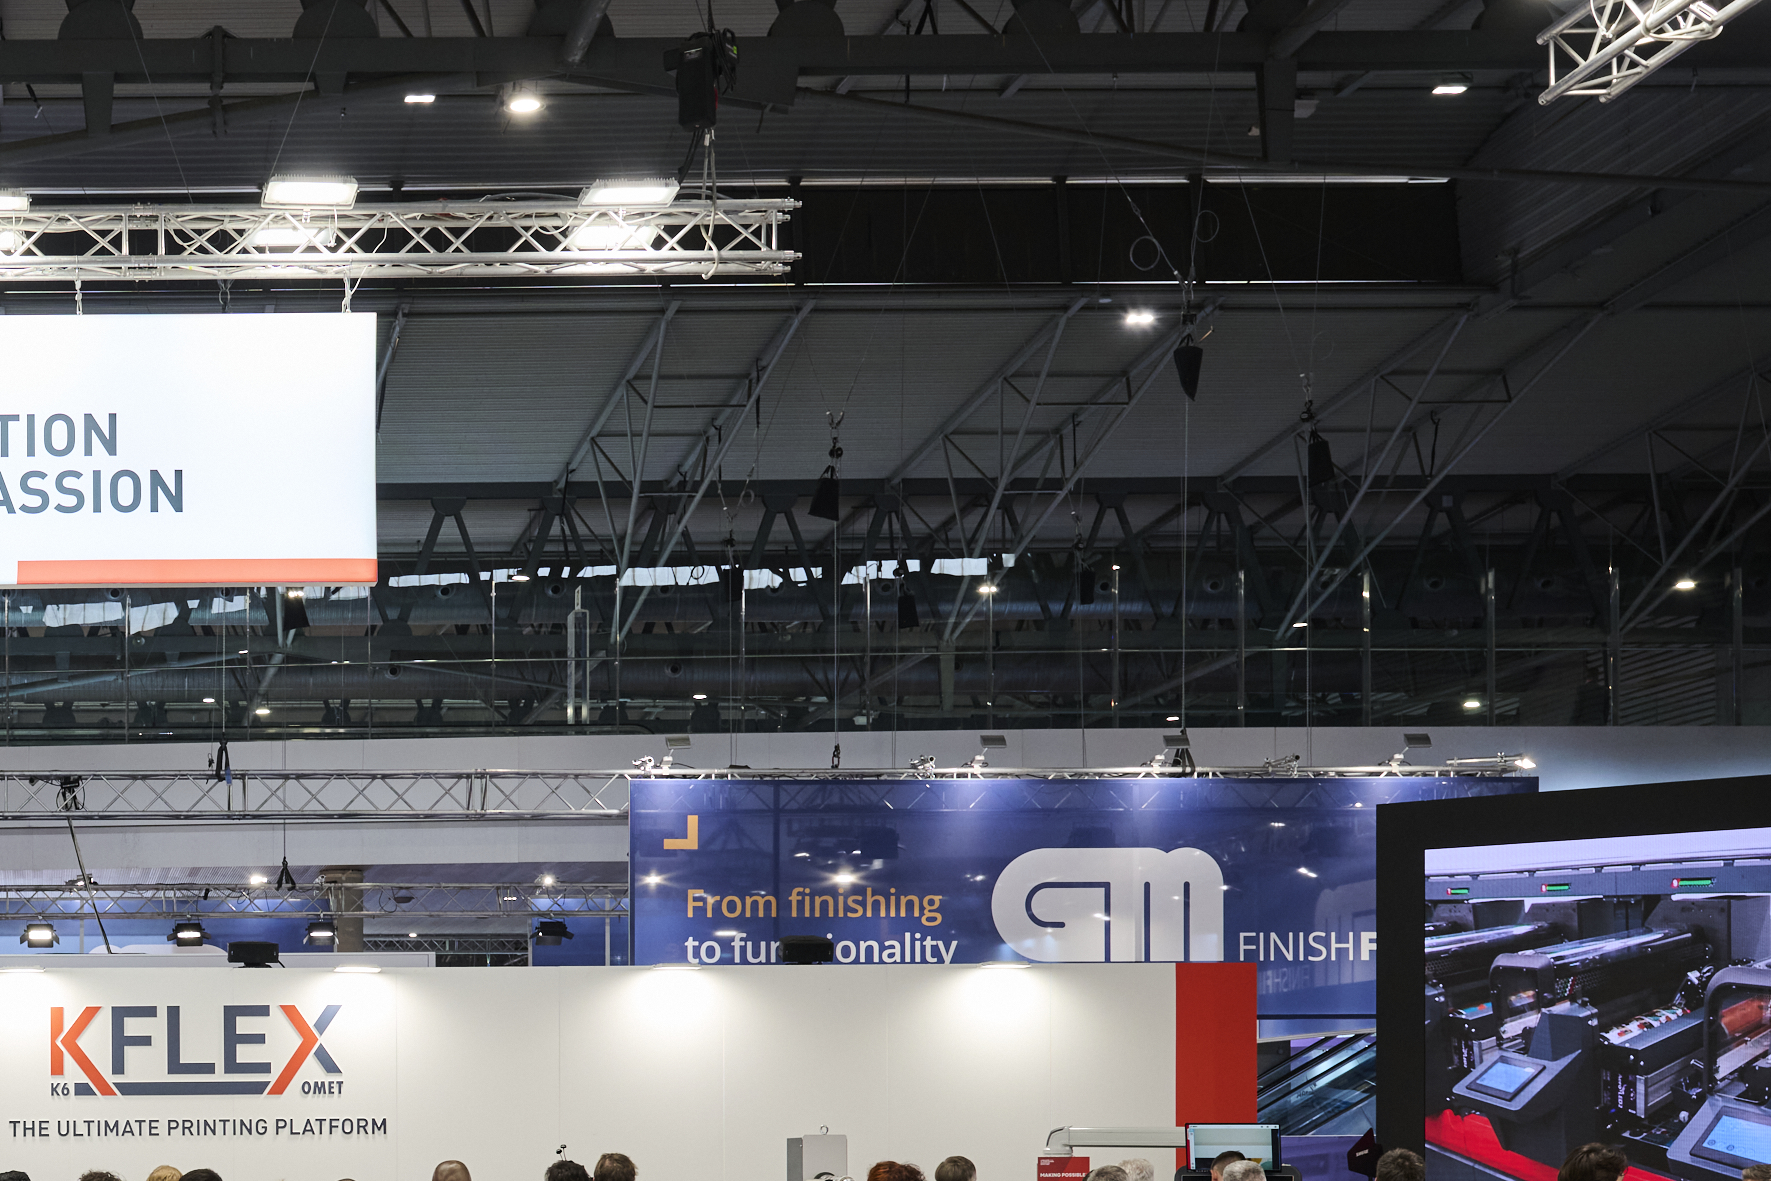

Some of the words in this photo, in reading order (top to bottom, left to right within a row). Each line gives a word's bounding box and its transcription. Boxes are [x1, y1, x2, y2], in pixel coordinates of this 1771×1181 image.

[687, 889, 777, 918] From
[789, 887, 943, 926] finishing
[685, 936, 721, 963] to
[50, 1004, 343, 1096] KFLEX
[50, 1083, 70, 1097] K6
[302, 1081, 344, 1095] OMET
[9, 1120, 50, 1137] THE
[57, 1119, 160, 1137] ULTIMATE
[167, 1119, 268, 1136] PRINTING
[275, 1117, 387, 1135] PLATFORM
